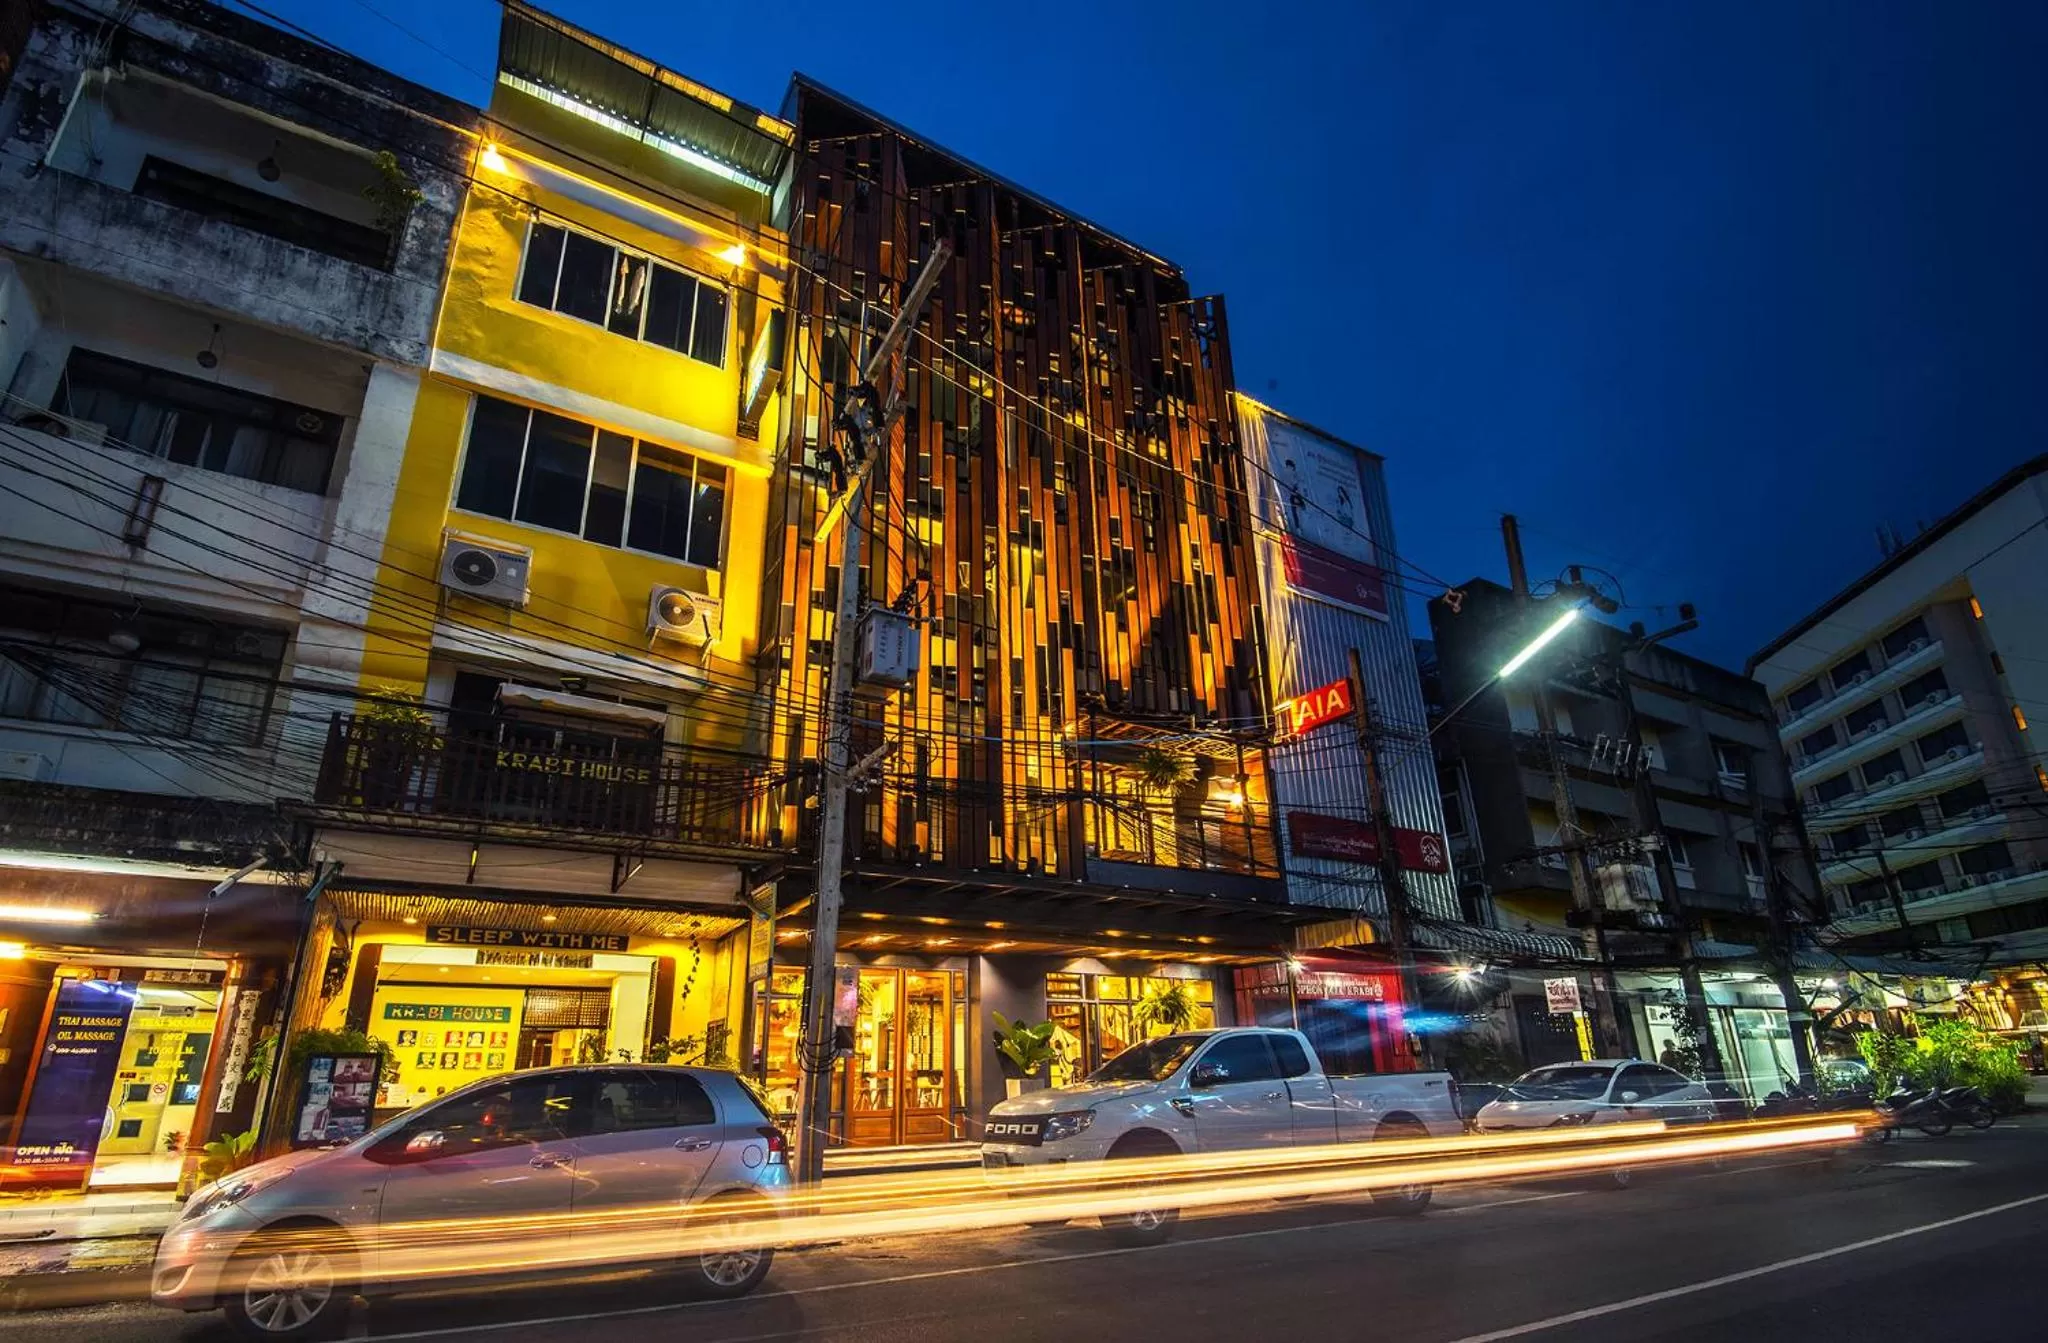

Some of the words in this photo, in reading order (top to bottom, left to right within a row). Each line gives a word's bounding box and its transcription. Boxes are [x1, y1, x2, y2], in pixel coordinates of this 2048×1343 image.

[1296, 688, 1346, 728] AIA
[496, 751, 576, 776] KRABI
[580, 761, 651, 785] HOUSE
[437, 927, 513, 944] SLEEP
[522, 931, 583, 948] WITH
[591, 935, 620, 950] ME
[452, 1007, 503, 1020] HOUSE
[58, 1016, 81, 1026] THAI
[81, 1017, 123, 1027] MASSAGE
[57, 1031, 73, 1040] OIL
[74, 1031, 116, 1041] MASSAGE
[984, 1122, 1040, 1135] FORD
[17, 1146, 51, 1156] OPEN
